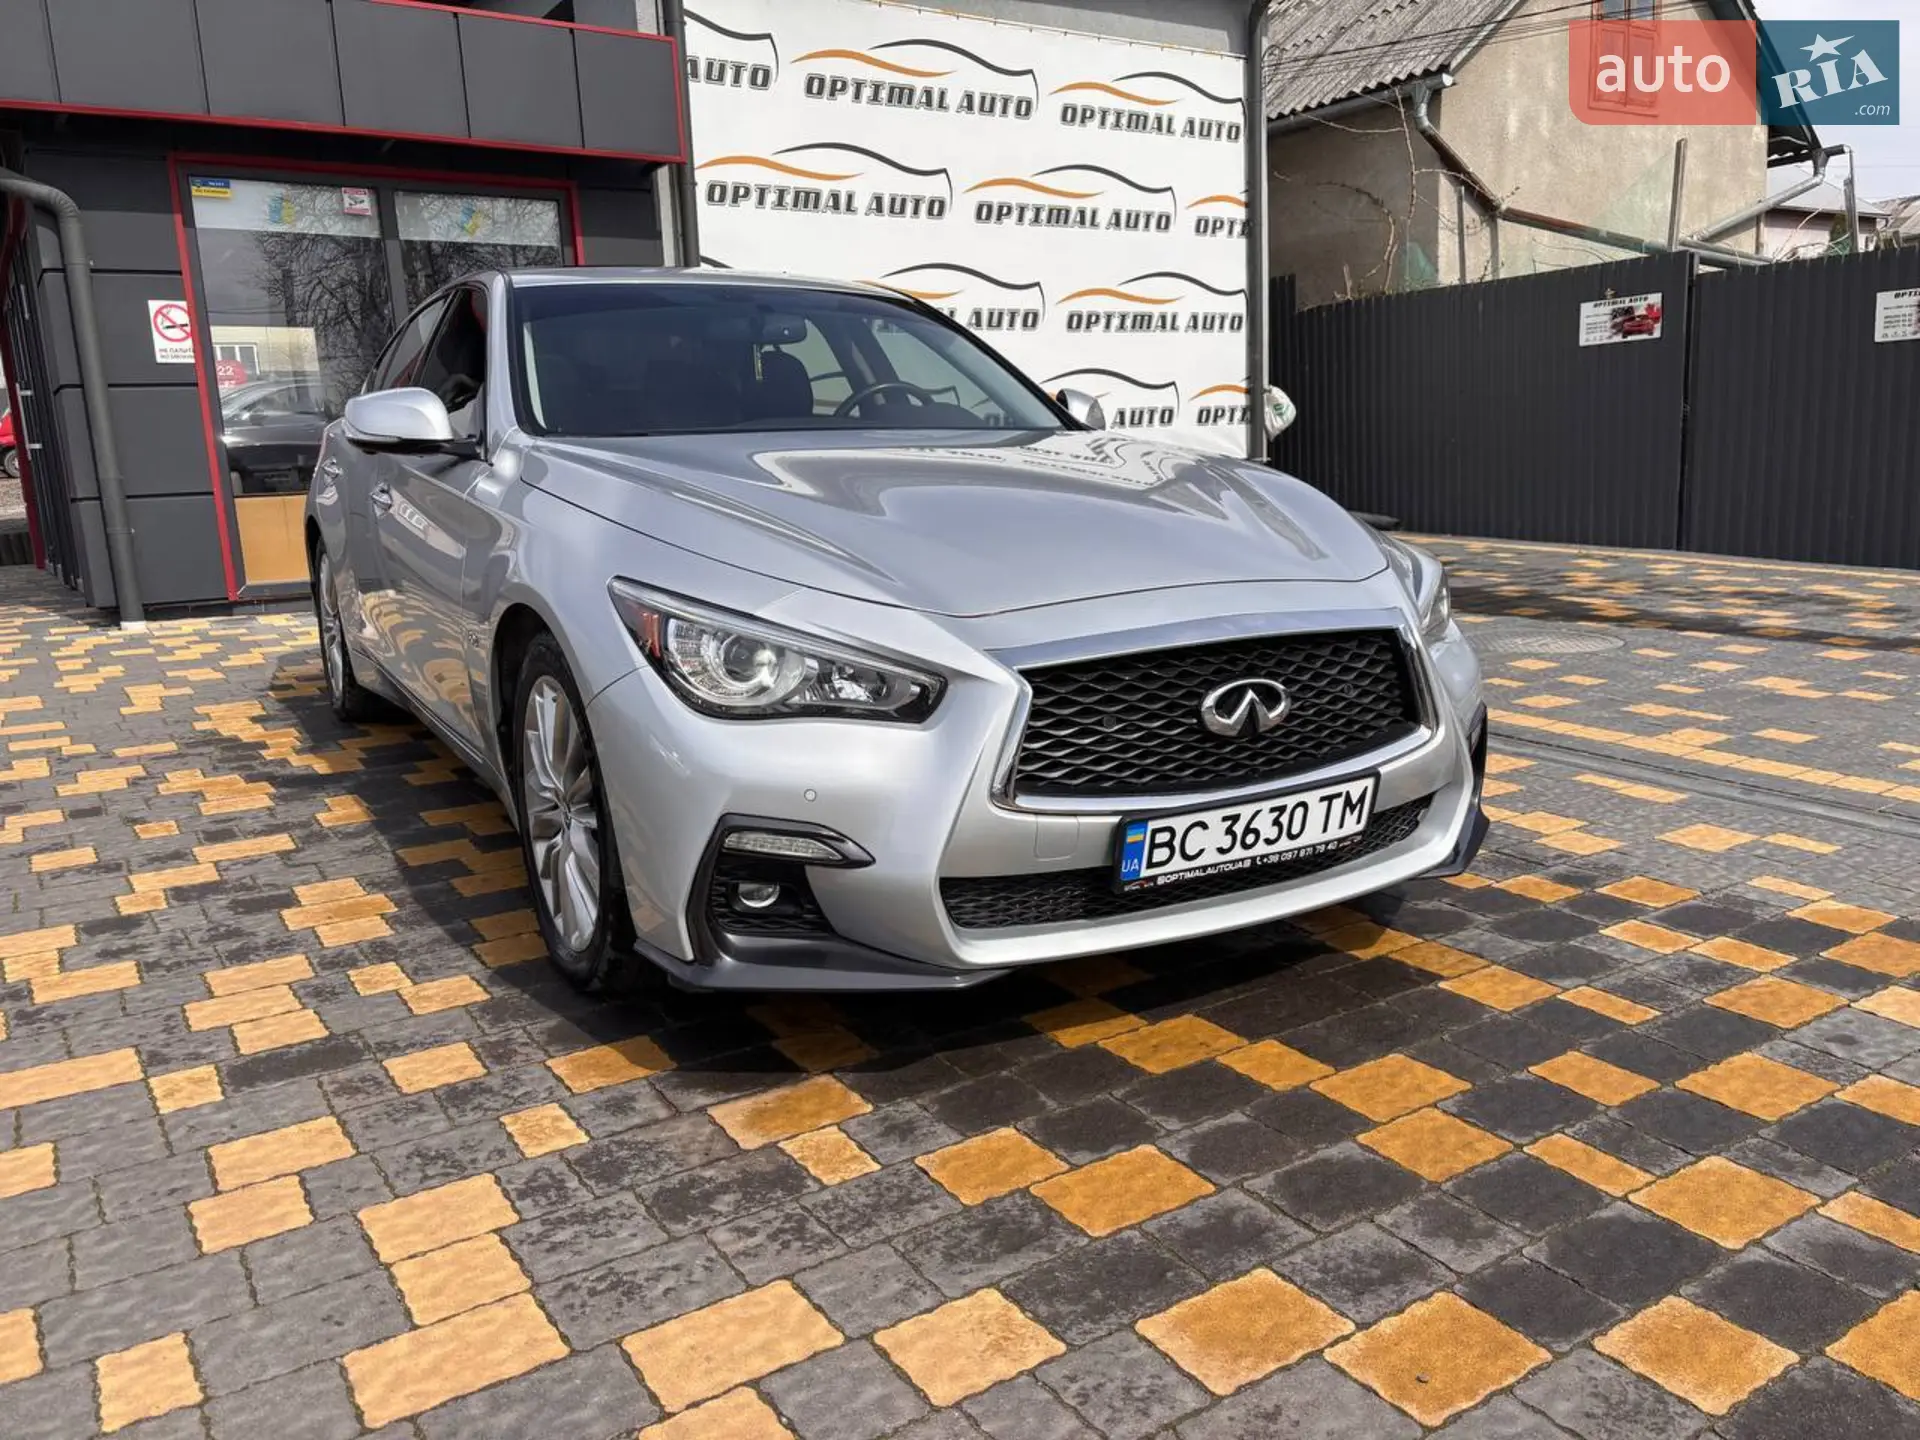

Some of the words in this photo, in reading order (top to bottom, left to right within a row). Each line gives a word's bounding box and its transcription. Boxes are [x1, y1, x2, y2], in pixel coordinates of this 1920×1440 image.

[804, 73, 951, 113] OPTIMAL
[956, 89, 1034, 121] AUTO
[1060, 102, 1176, 137] OPTIMAL
[1181, 116, 1242, 143] AUTO
[706, 179, 859, 216] OPTIMAL
[864, 192, 947, 220] AUTO
[975, 200, 1101, 230] OPTIMAL
[1105, 208, 1172, 233] AUTO
[1194, 215, 1248, 239] OPTI
[966, 306, 1040, 331] AUTO
[1066, 310, 1180, 334] OPTIMAL
[1184, 311, 1244, 333] AUTO
[1110, 406, 1174, 429] AUTO
[1196, 405, 1250, 426] OPTI
[1145, 820, 1210, 870] BC
[1216, 800, 1310, 855] 3630
[1319, 785, 1369, 834] TM
[1121, 858, 1140, 873] UA
